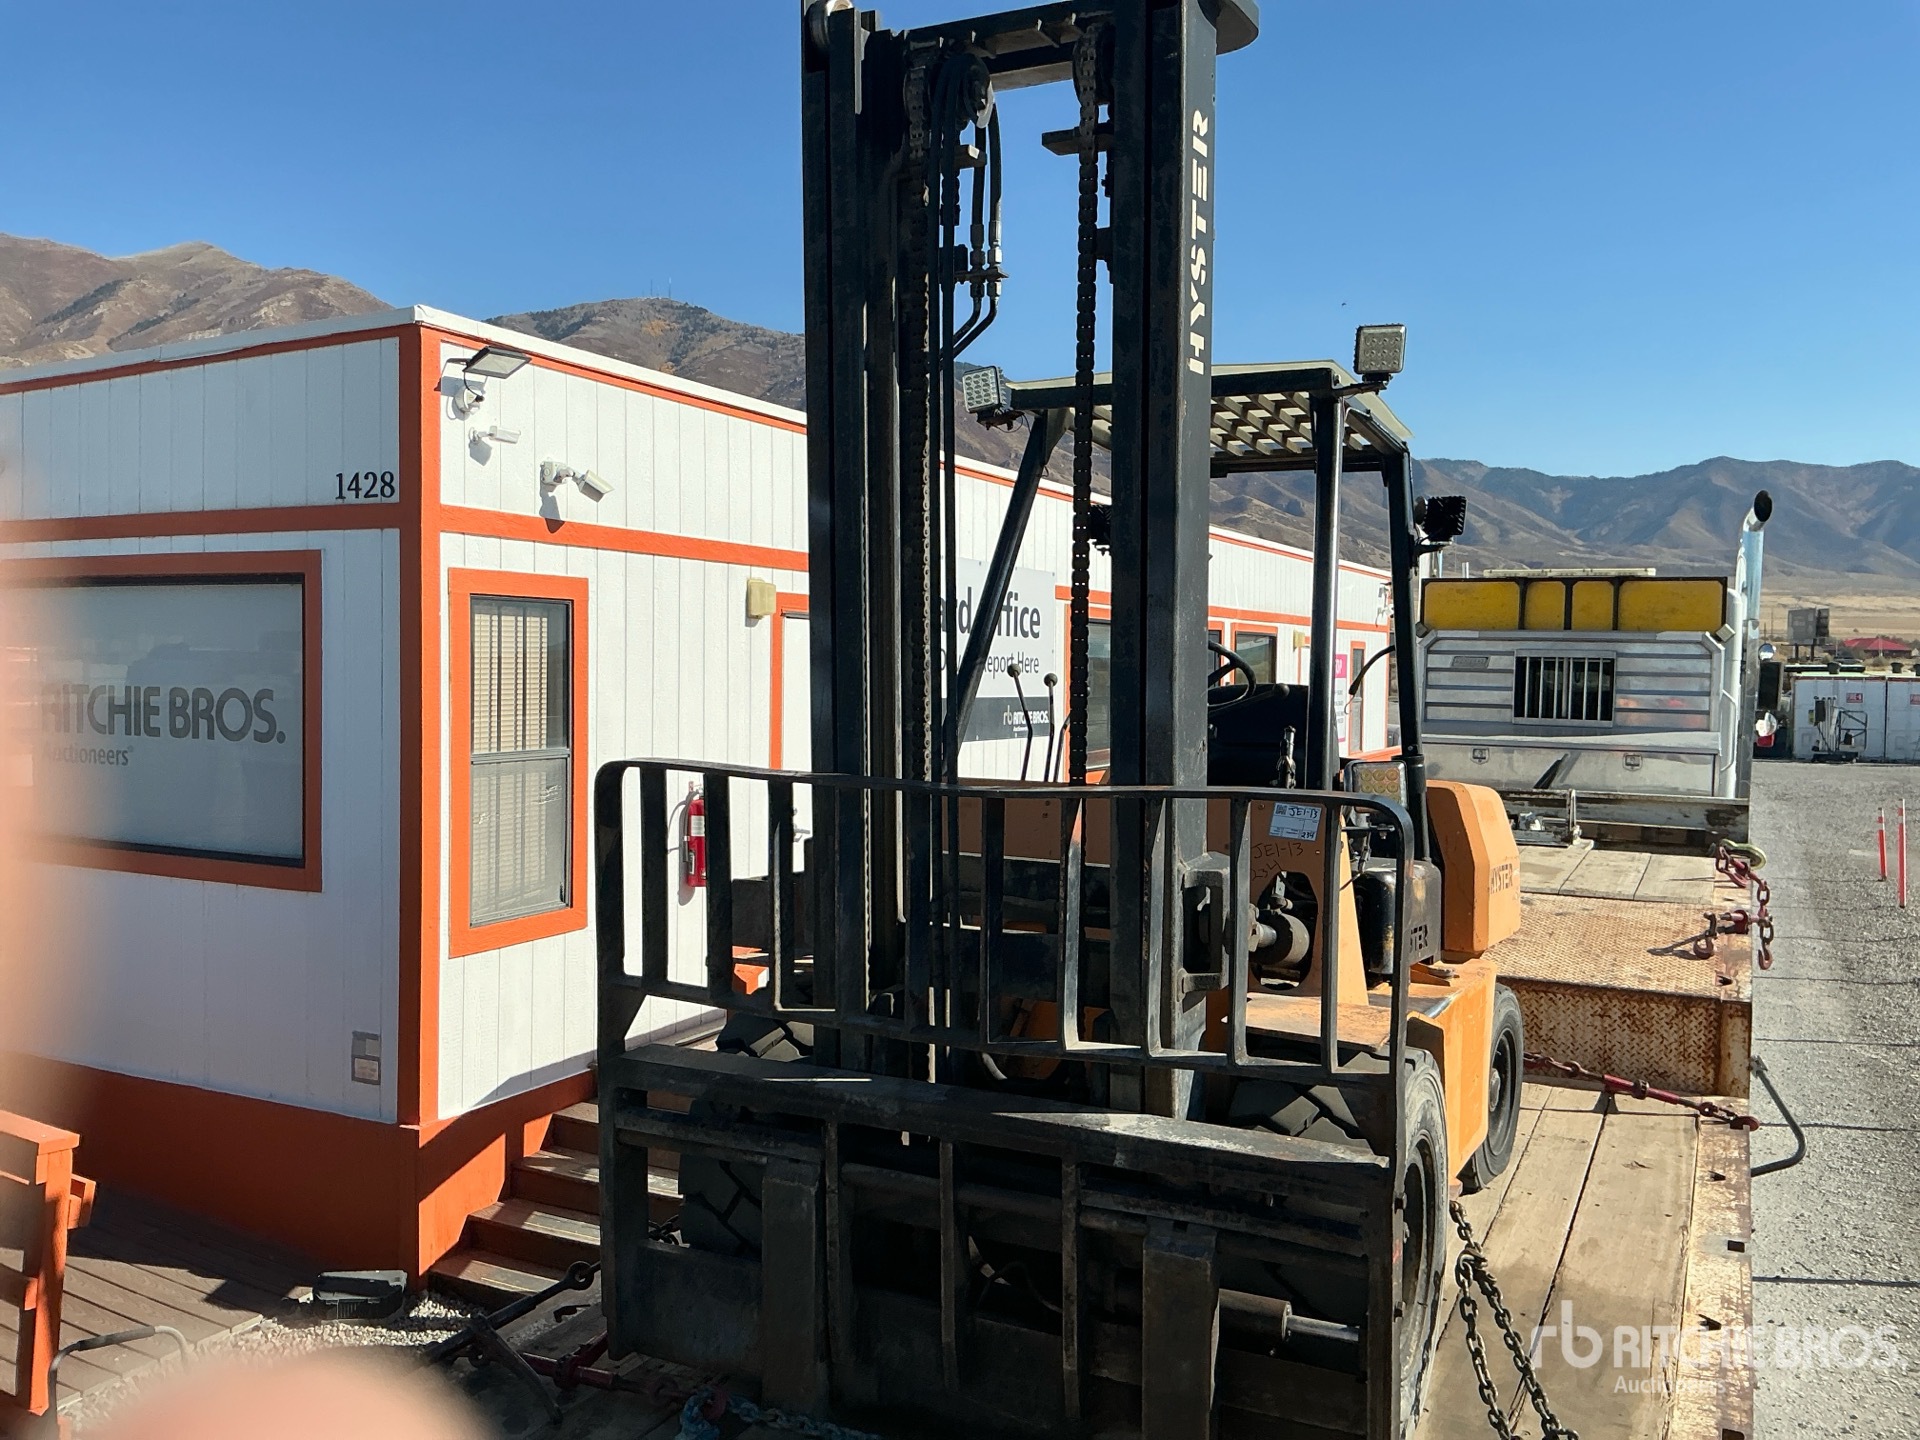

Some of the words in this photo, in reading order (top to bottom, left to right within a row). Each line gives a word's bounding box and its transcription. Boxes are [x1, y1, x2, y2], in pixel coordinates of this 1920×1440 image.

[1189, 109, 1208, 375] HYSTER
[335, 471, 396, 500] 1428
[984, 652, 1015, 679] eport
[1017, 651, 1040, 674] Here
[41, 683, 161, 738] RITCHIE
[168, 686, 287, 744] BROS.
[1301, 831, 1316, 839] 234
